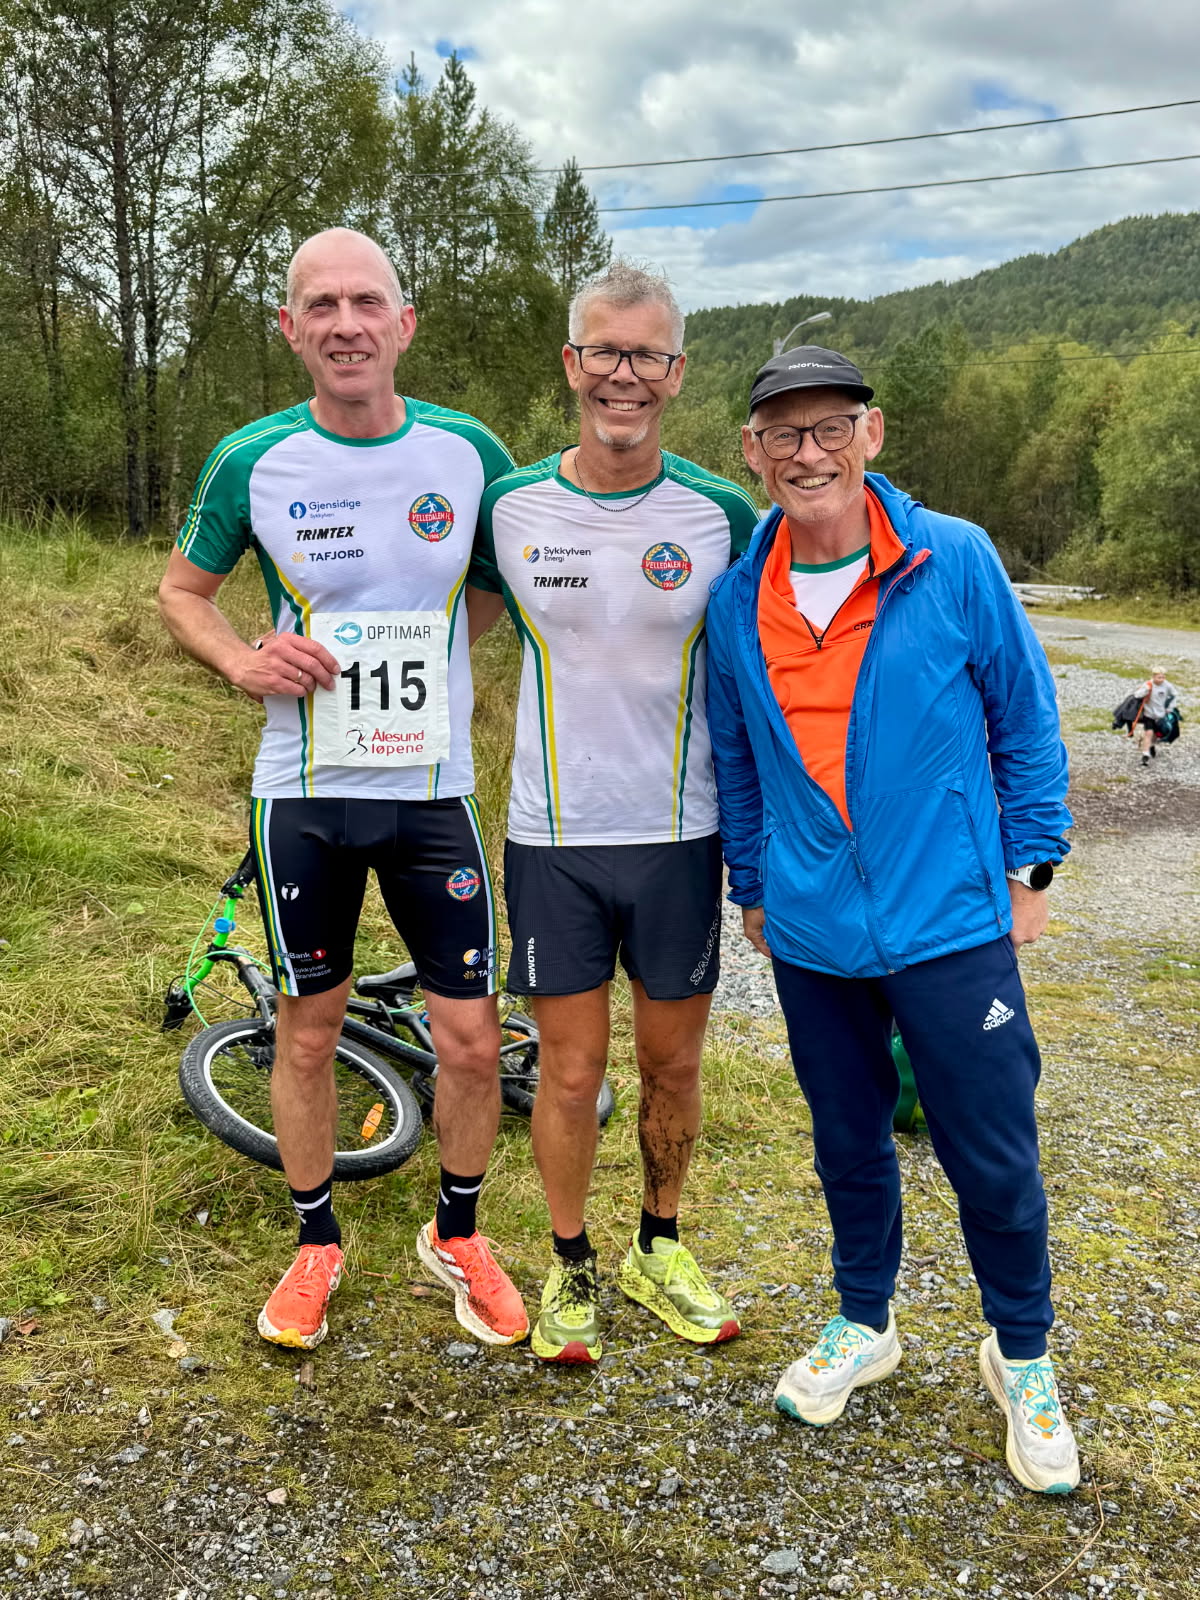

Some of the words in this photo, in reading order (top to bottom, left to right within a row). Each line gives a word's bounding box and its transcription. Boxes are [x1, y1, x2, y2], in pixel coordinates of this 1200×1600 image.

[308, 499, 361, 512] Gjensidige
[412, 512, 445, 521] VELLEDALEN
[296, 526, 355, 541] TRIMTEX
[308, 549, 364, 562] TAFJORD
[543, 546, 591, 557] Sykkylven
[645, 561, 681, 569] VELLEDALEN
[533, 577, 589, 588] TRIMTEX
[367, 625, 431, 640] OPTIMAR
[340, 660, 427, 711] 115
[371, 728, 424, 742] Ålesund
[371, 743, 424, 756] løpene
[982, 1008, 1015, 1031] adidas
